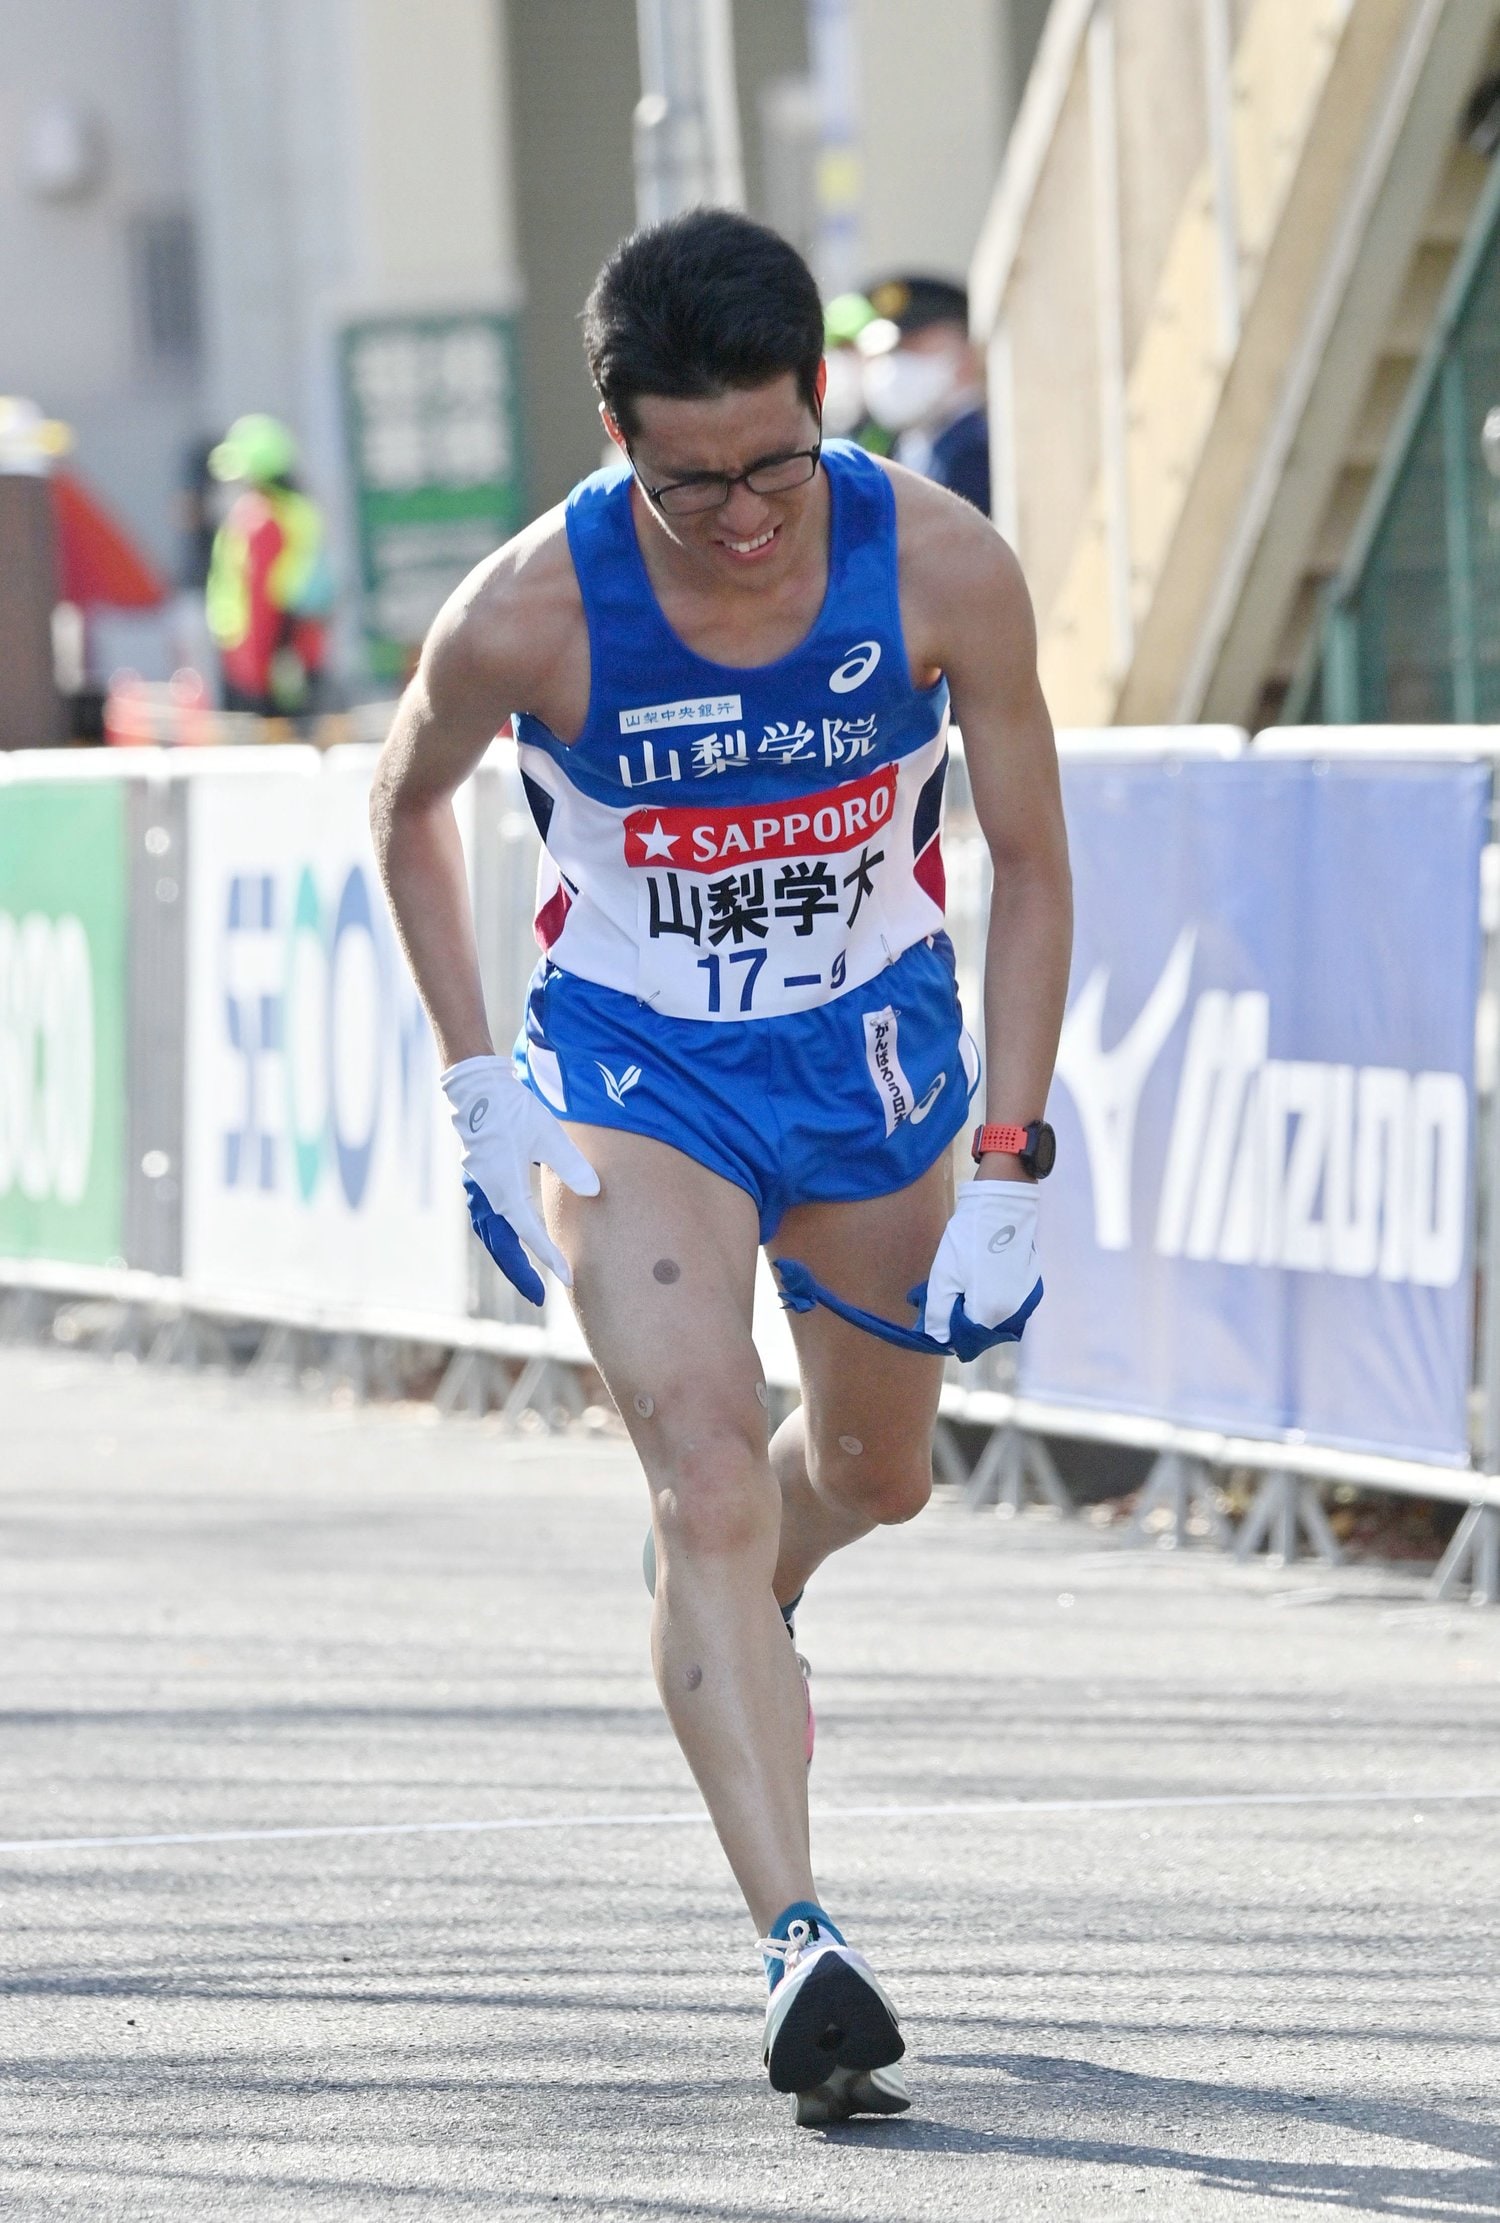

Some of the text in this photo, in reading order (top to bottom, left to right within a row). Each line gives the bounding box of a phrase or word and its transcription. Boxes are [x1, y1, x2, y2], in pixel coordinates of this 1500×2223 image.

[619, 713, 877, 788] 山梨学院
[625, 702, 735, 727] 山梨中央銀行
[692, 786, 890, 862] SAPPORO
[646, 846, 885, 947] 山梨学大
